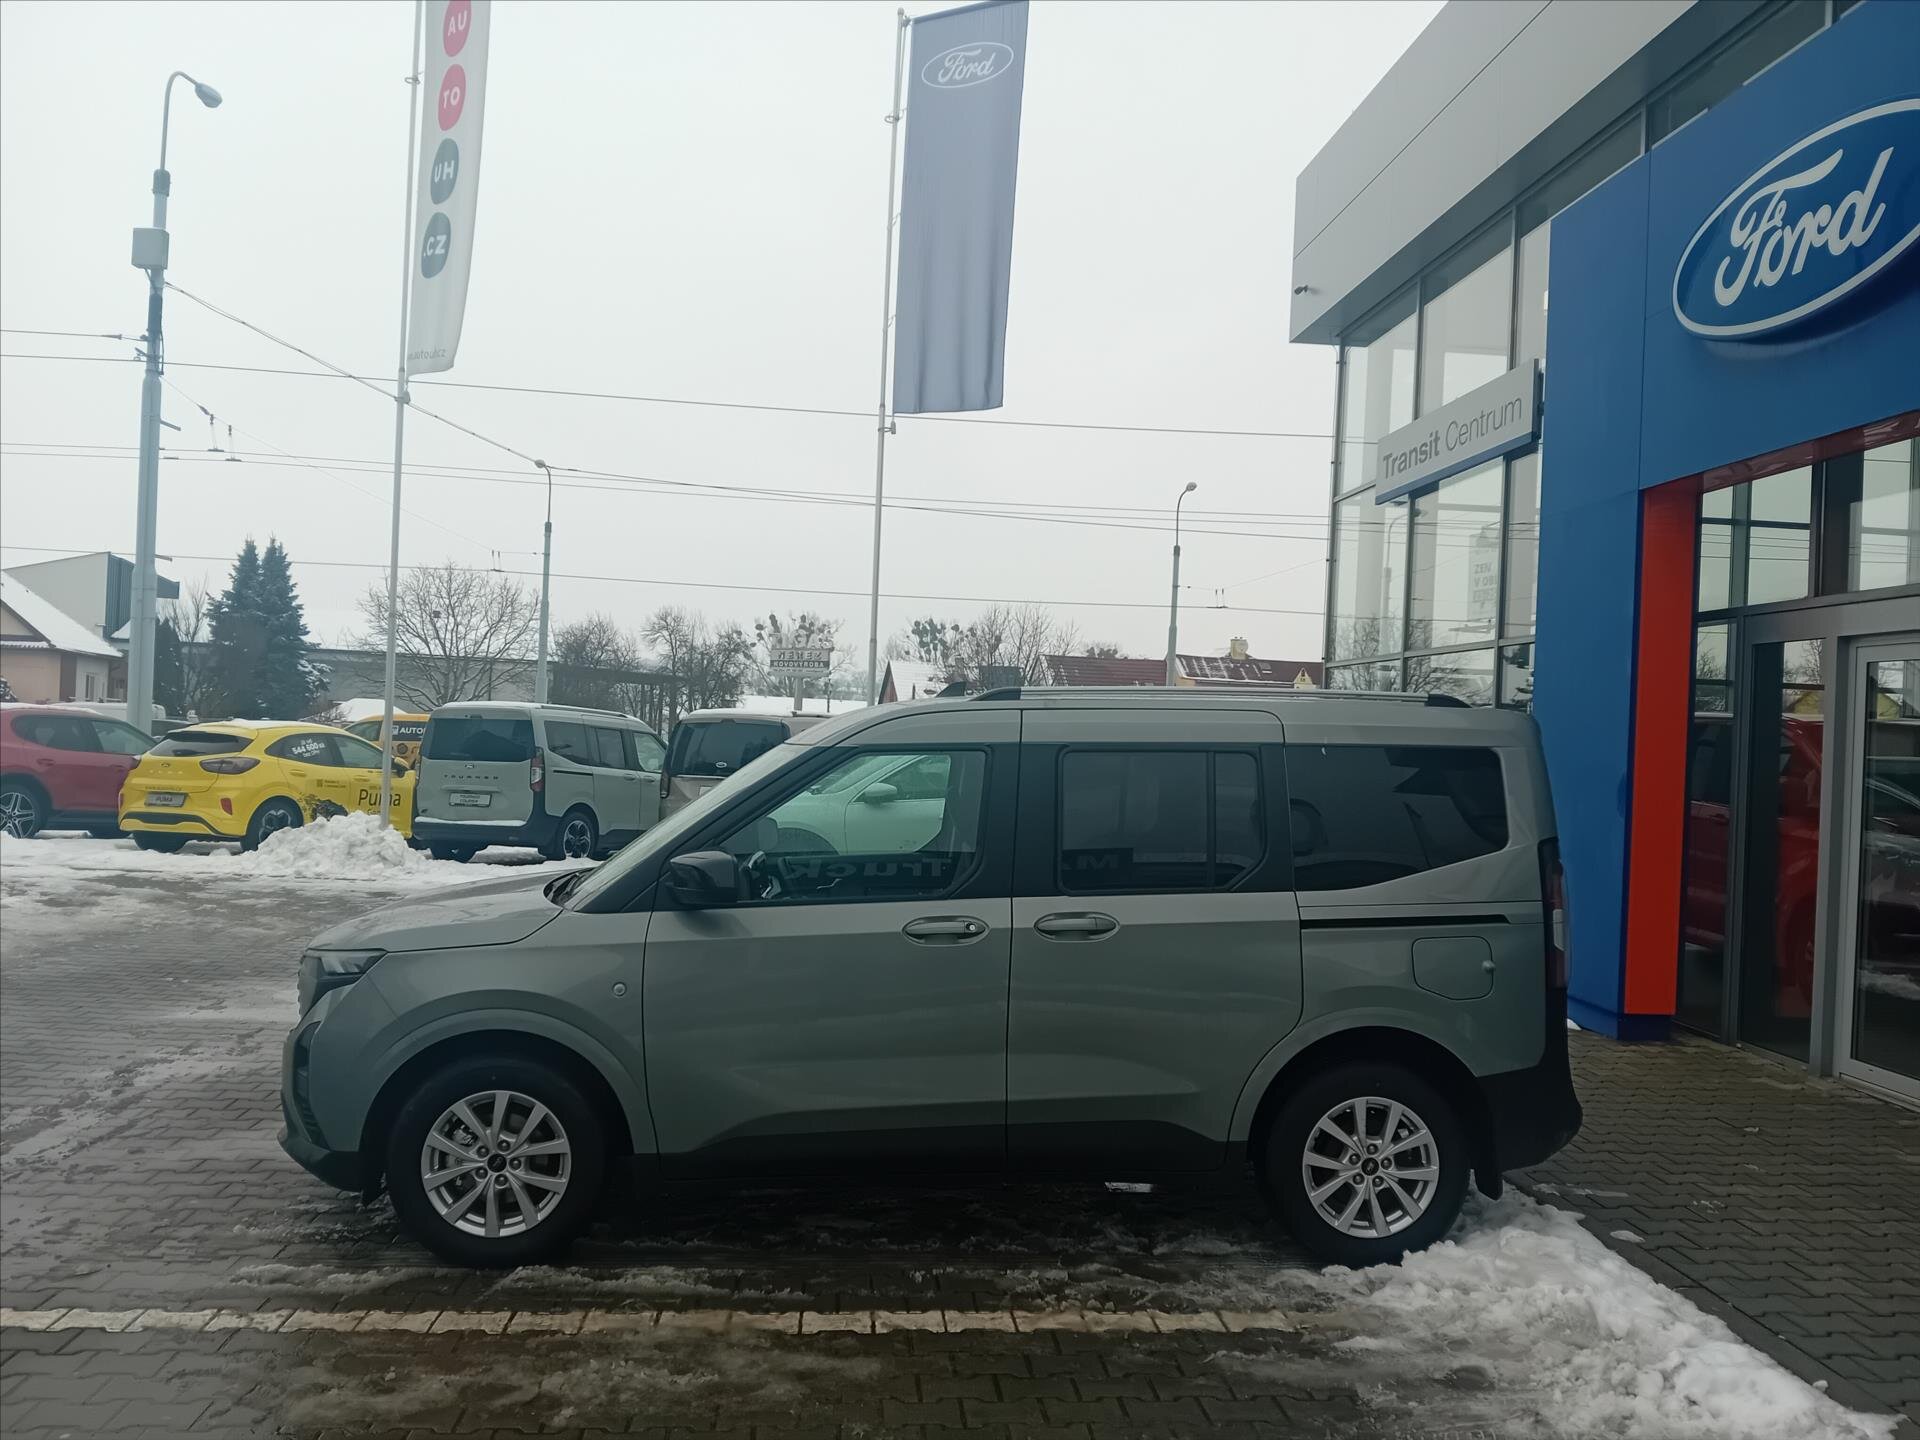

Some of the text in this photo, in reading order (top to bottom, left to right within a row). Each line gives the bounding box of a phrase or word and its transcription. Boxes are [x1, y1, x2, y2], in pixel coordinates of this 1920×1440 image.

[447, 10, 468, 37] AU
[938, 48, 996, 83] Ford
[443, 85, 461, 109] TO
[434, 160, 455, 183] UH
[1714, 146, 1894, 306] Ford
[1383, 397, 1522, 479] Transit Centrum
